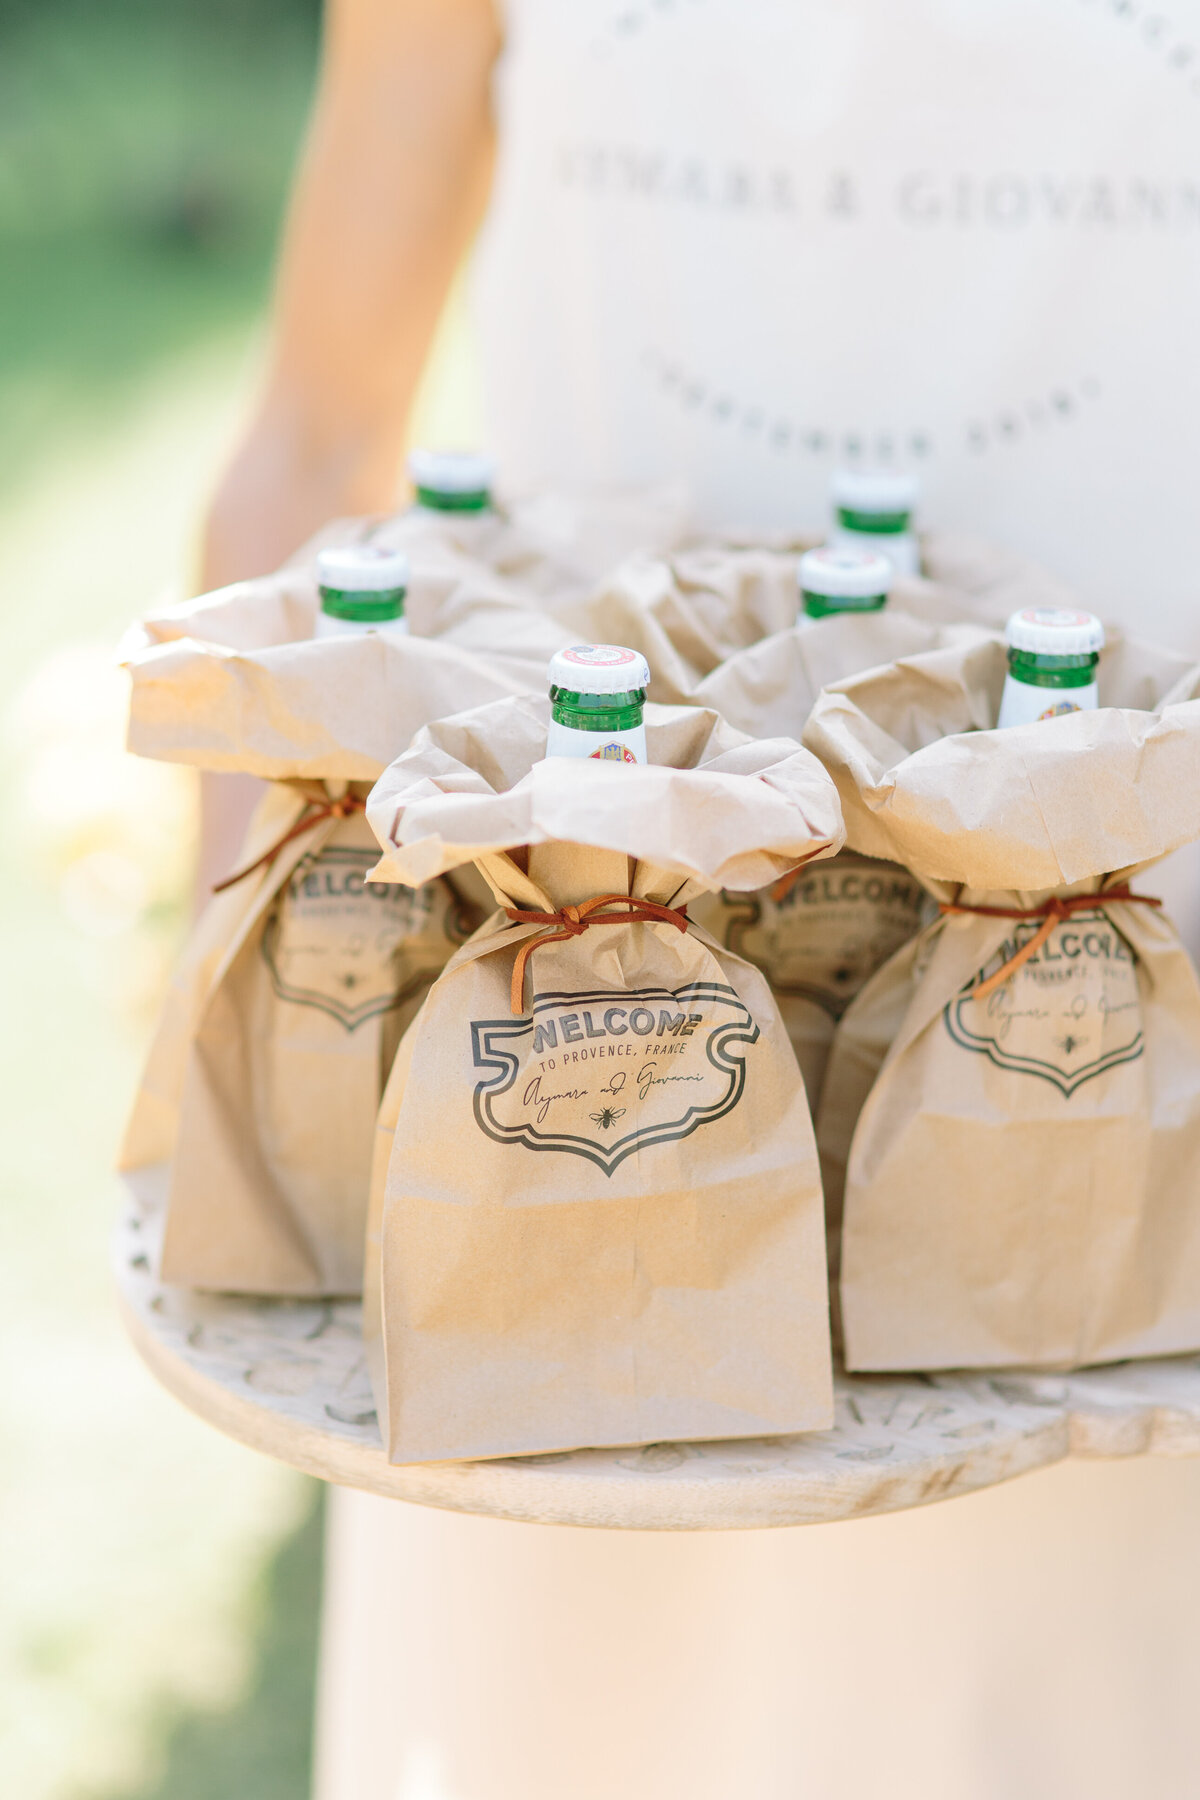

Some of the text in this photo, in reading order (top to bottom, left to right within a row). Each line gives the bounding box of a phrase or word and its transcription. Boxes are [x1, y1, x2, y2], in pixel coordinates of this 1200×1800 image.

[532, 1007, 703, 1054] WELCOME
[539, 1042, 688, 1074] TO PROVENCE, FRANCE
[600, 1071, 627, 1095] and
[636, 1061, 705, 1101] Giovanni
